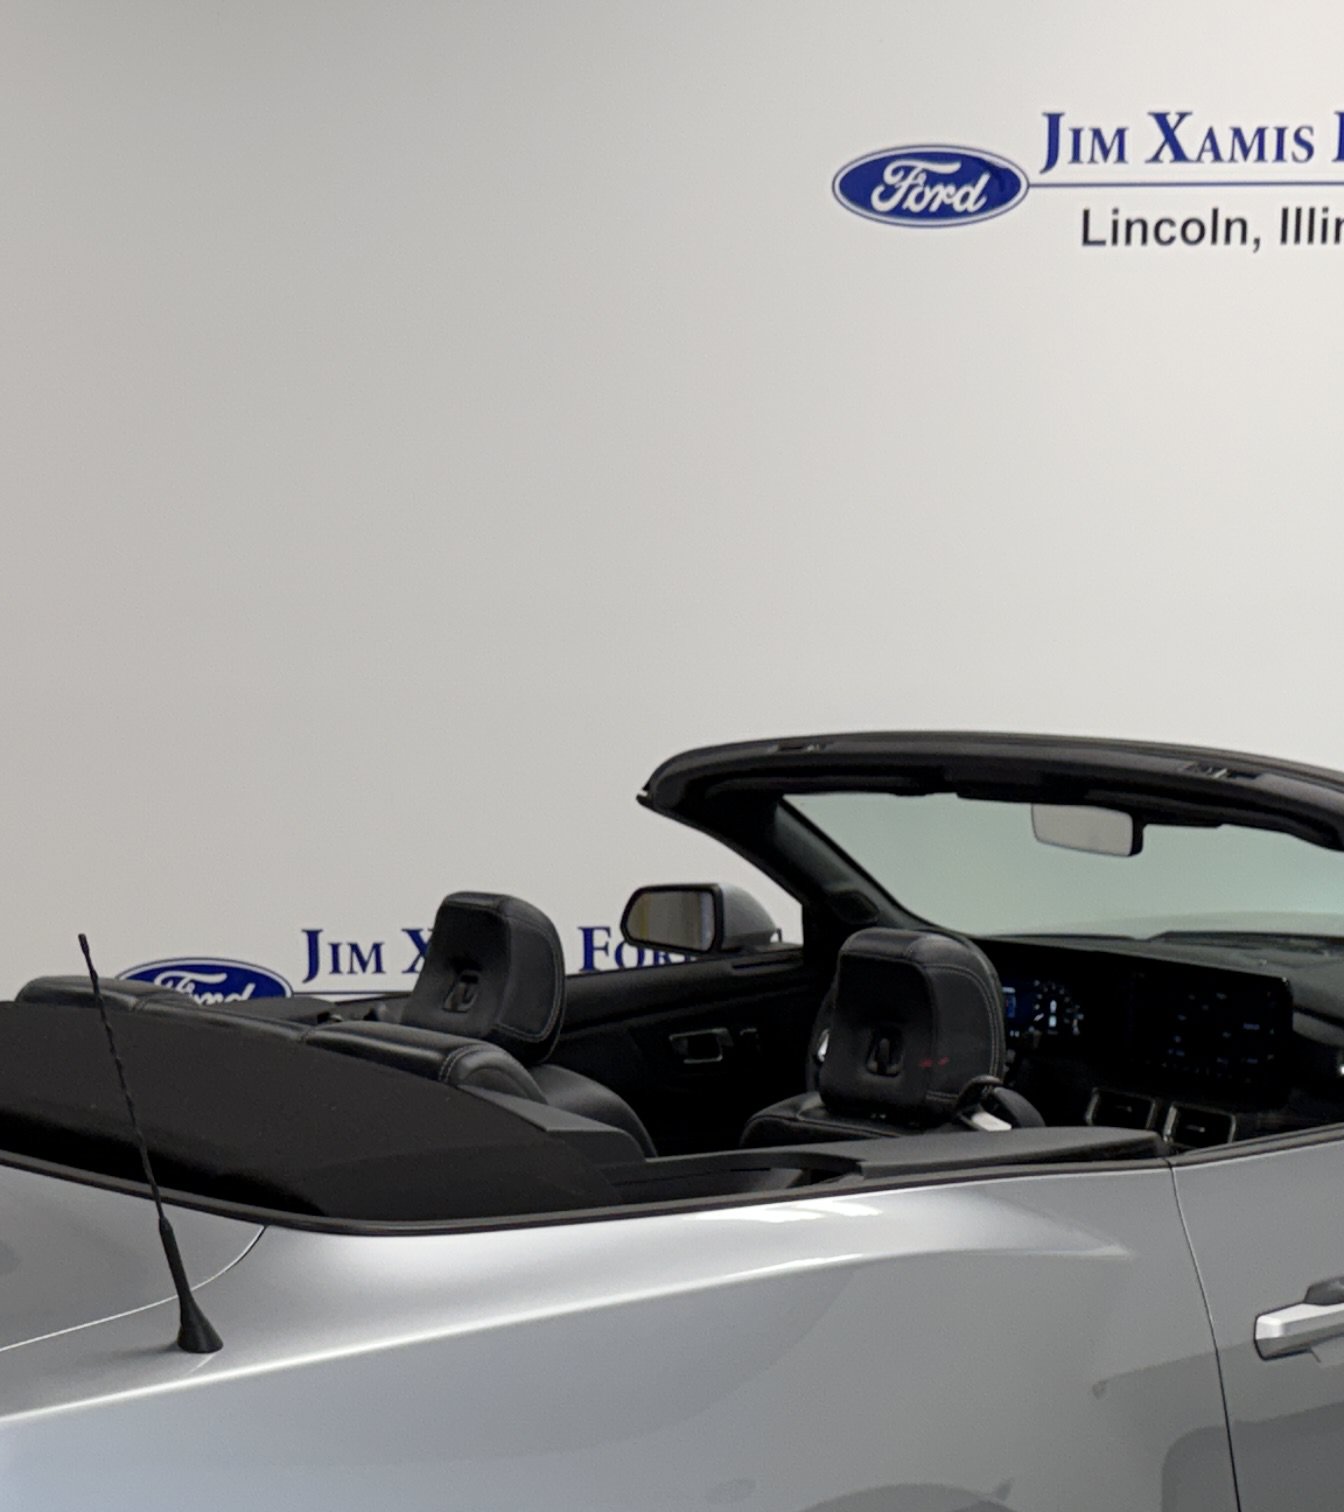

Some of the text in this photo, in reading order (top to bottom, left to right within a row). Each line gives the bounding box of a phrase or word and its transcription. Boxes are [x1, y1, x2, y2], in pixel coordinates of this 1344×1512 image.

[1039, 112, 1129, 175] JIM
[1145, 111, 1316, 164] XAMIS
[870, 158, 991, 213] Ford
[1081, 207, 1262, 254] Lincoln,
[300, 928, 387, 984] JIM
